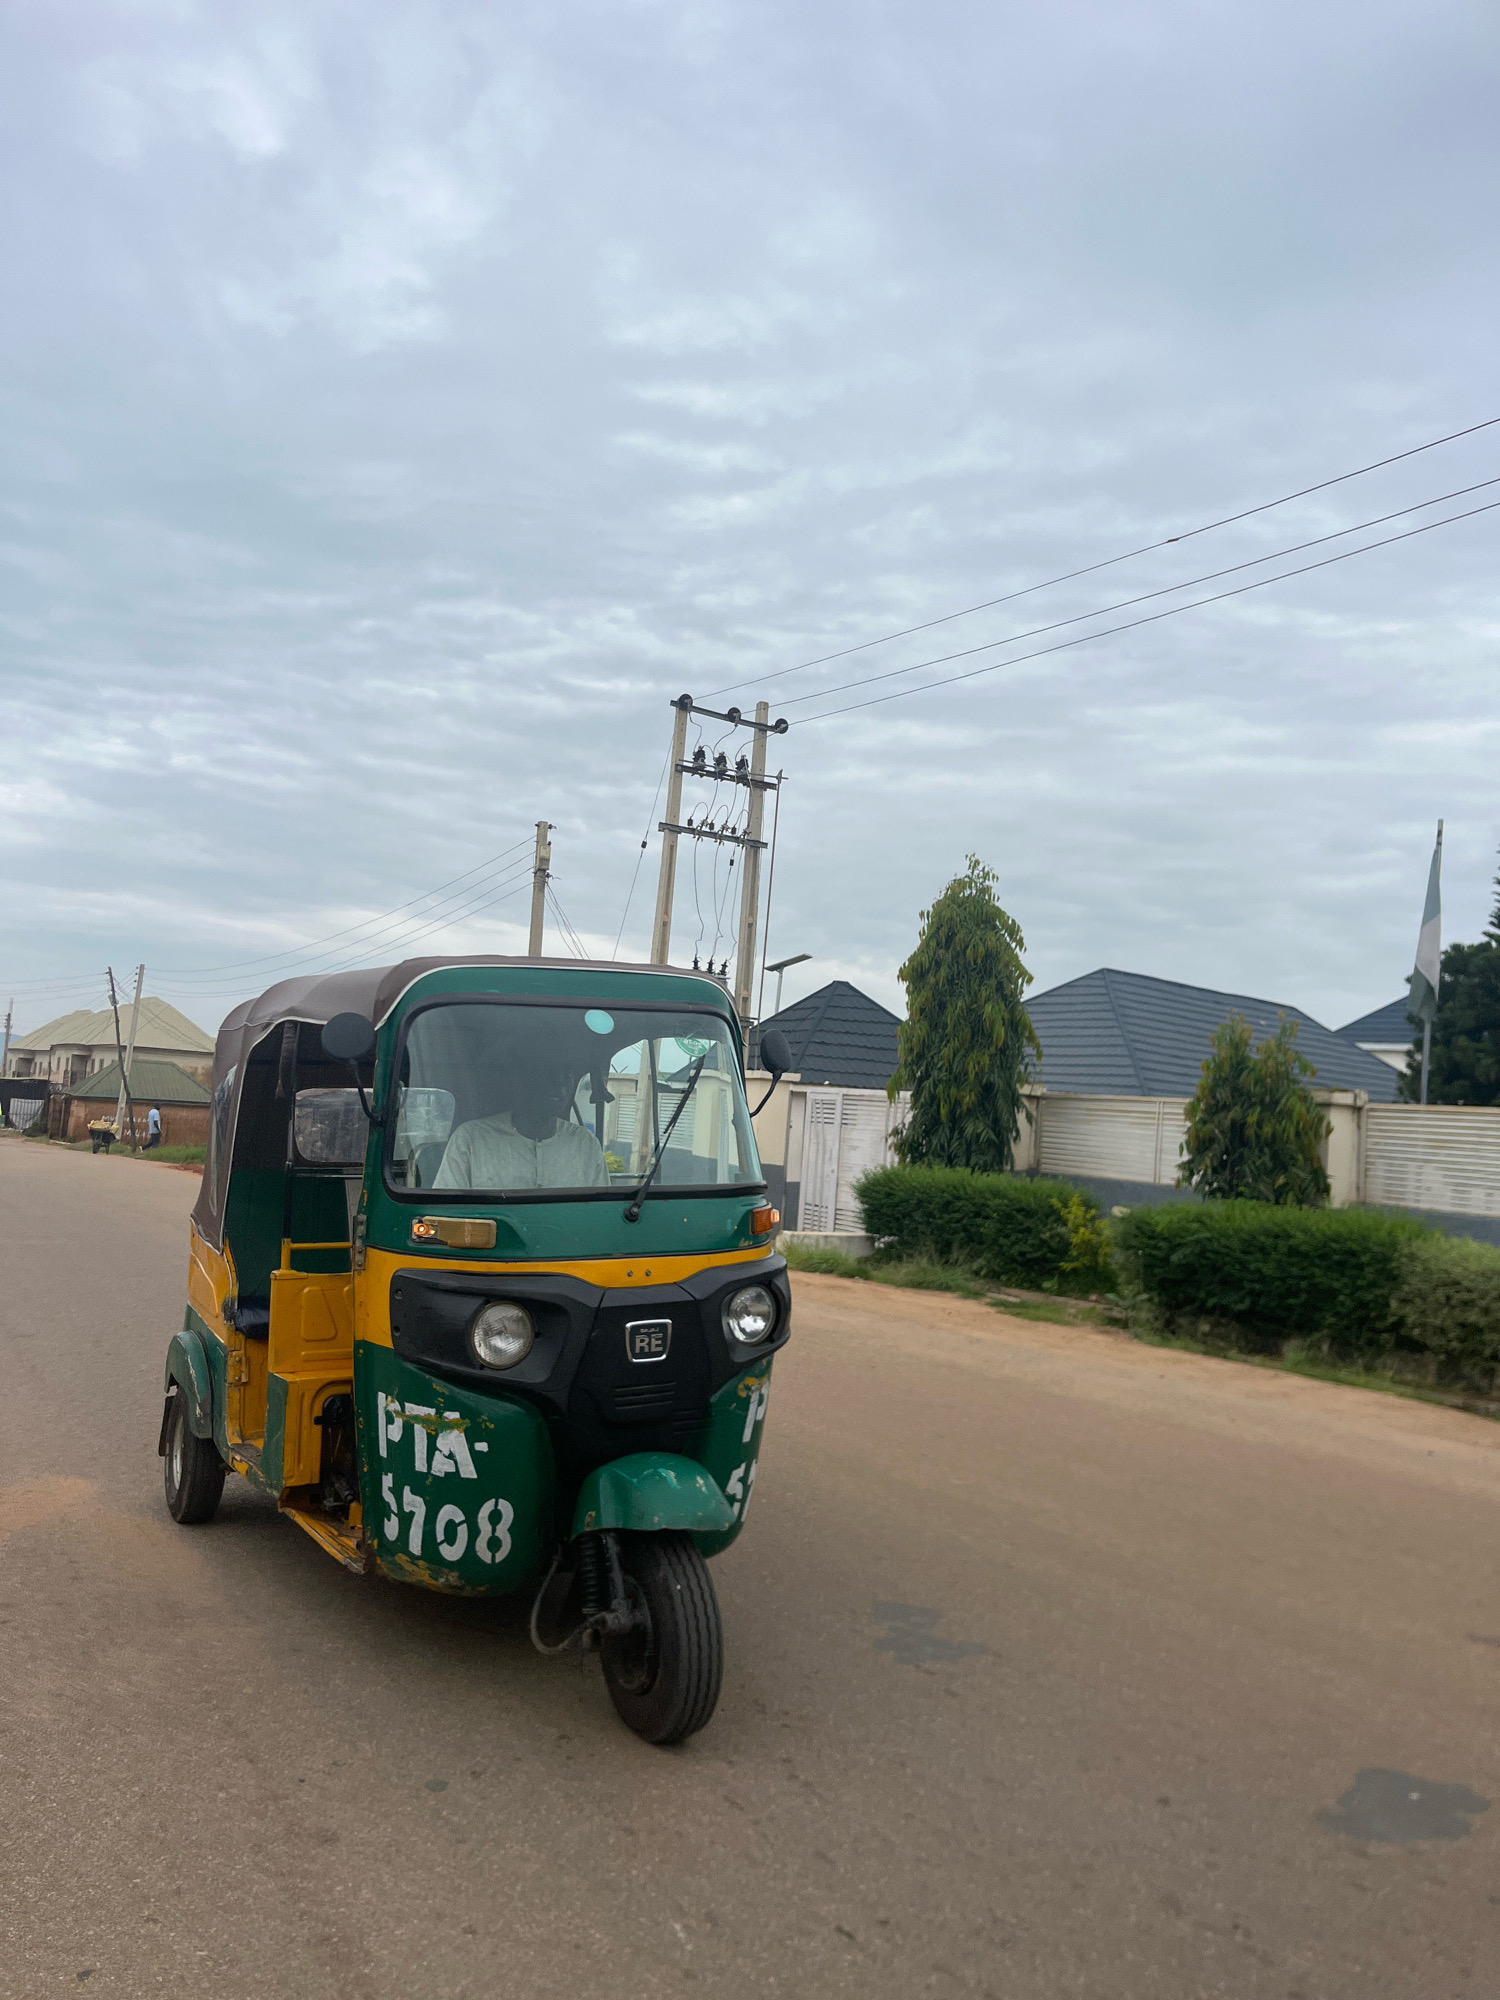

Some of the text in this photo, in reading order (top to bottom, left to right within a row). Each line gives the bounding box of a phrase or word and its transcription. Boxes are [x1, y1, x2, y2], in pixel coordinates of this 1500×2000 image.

[635, 1333, 664, 1353] RE
[377, 1391, 489, 1479] PTA-
[382, 1473, 514, 1564] 5708
